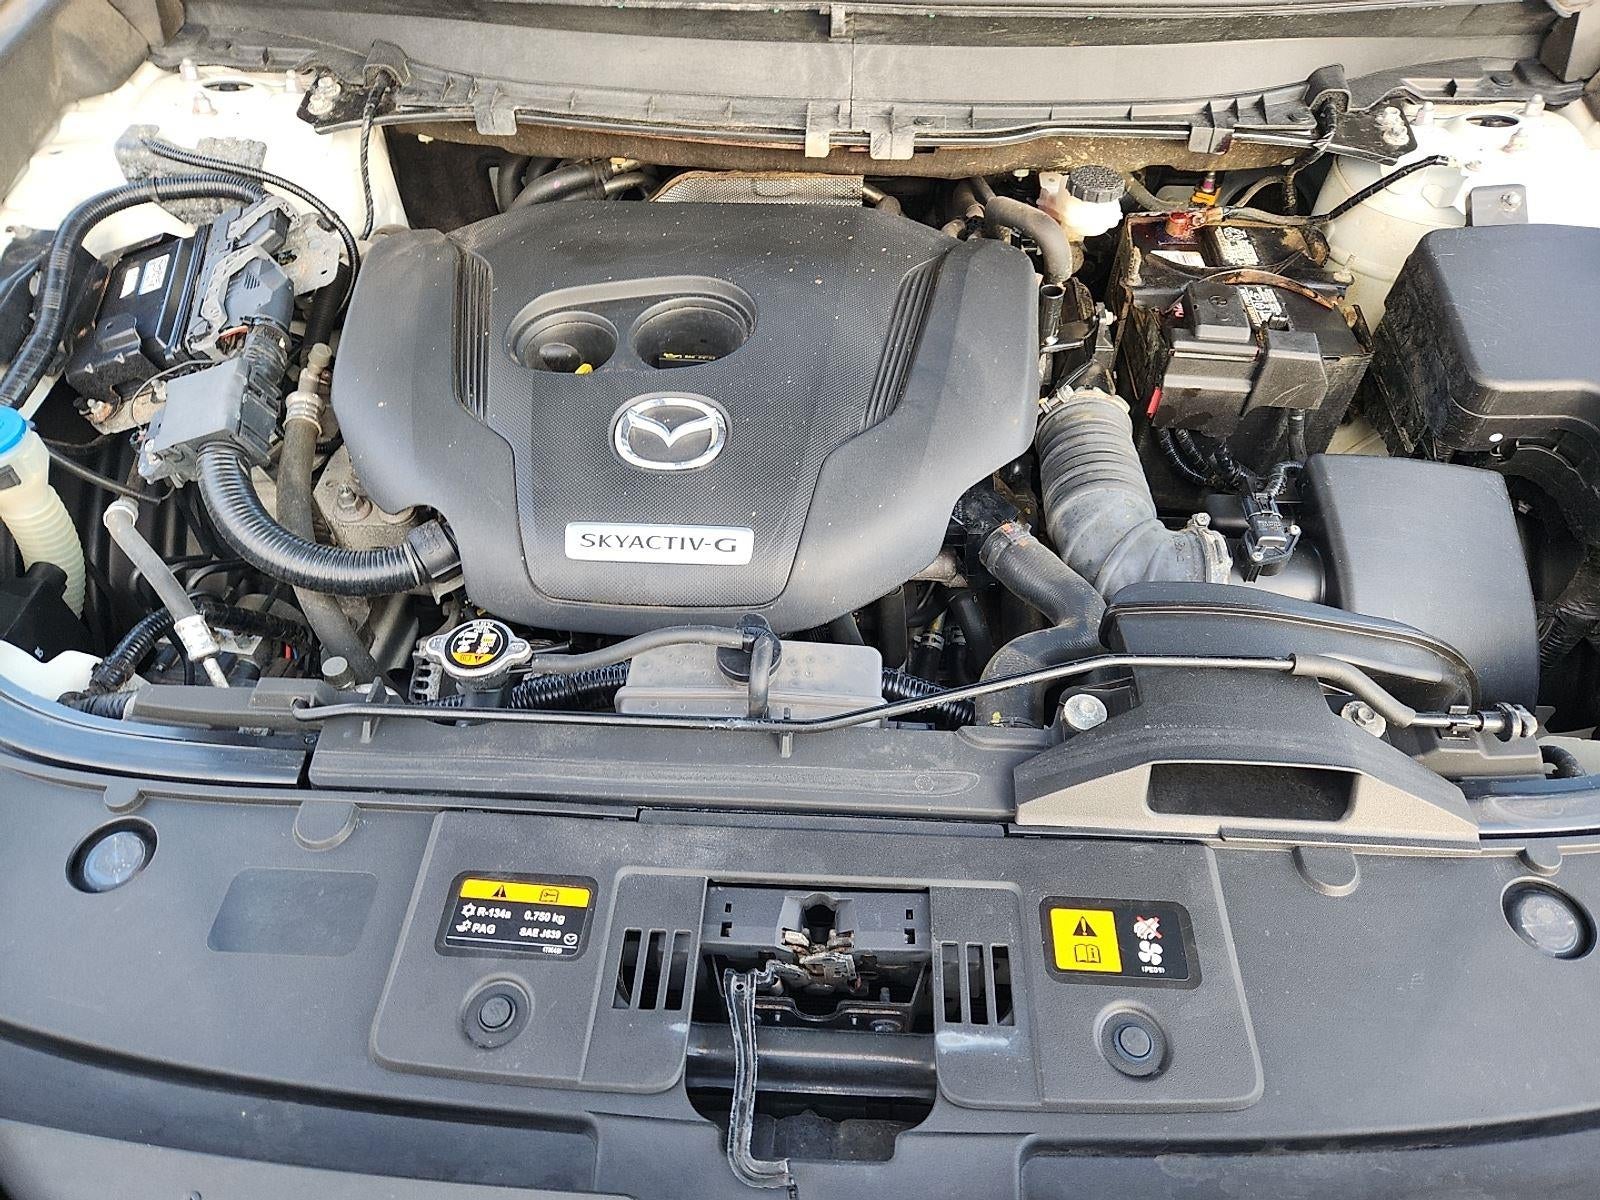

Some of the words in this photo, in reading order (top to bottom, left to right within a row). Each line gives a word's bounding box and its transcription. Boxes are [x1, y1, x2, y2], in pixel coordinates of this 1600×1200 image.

[580, 533, 737, 552] SKYACTIV-G
[476, 906, 512, 919] R-134a
[552, 912, 566, 926] kg
[471, 923, 496, 935] PAG
[519, 927, 539, 938] SAE
